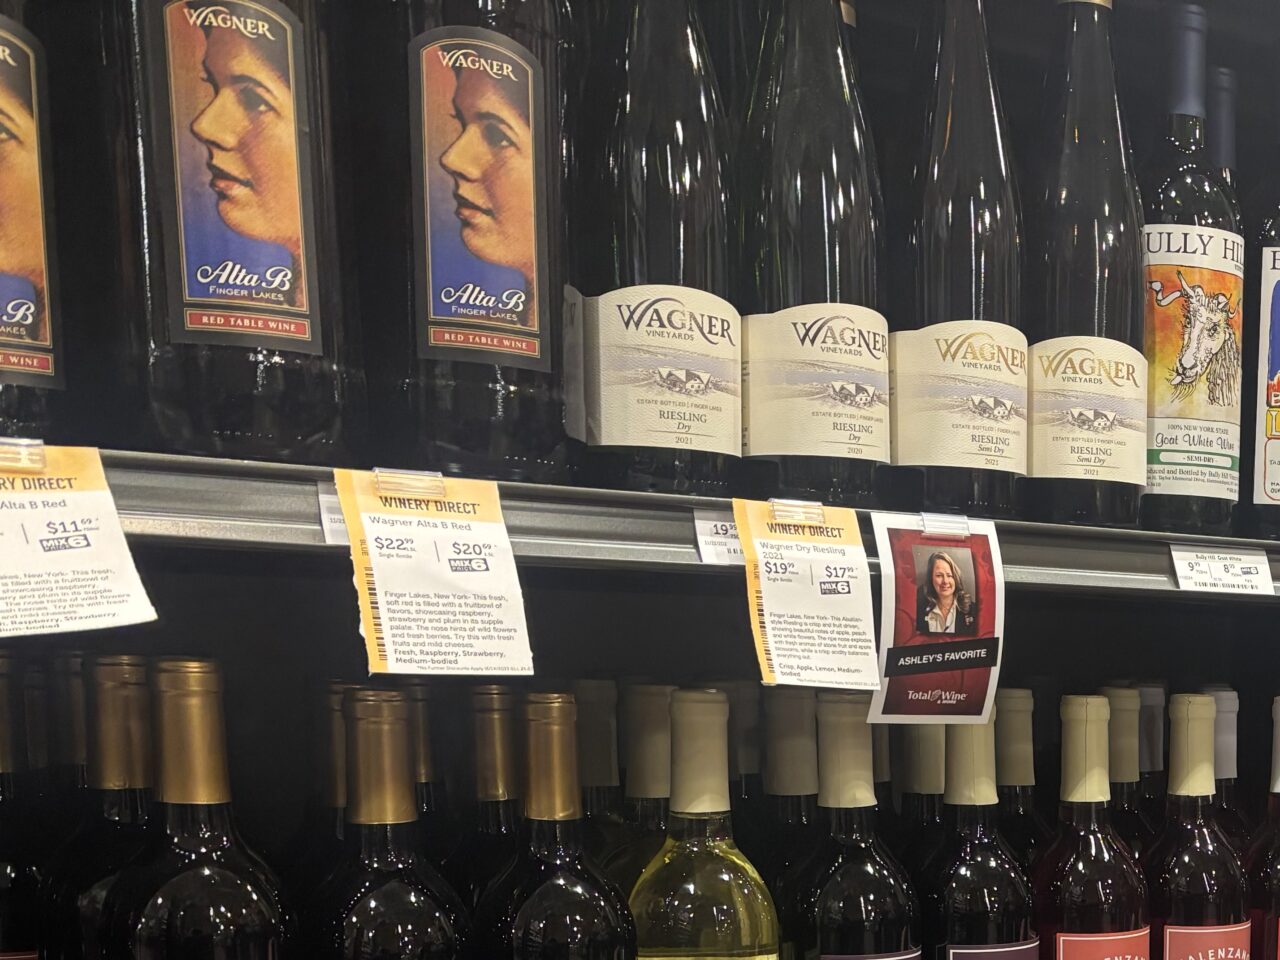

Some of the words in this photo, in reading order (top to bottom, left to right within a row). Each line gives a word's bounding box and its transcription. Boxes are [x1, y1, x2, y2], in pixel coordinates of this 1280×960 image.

[185, 6, 276, 40] WAGNER
[438, 48, 518, 81] WAGNER
[197, 260, 260, 288] Alta
[261, 266, 292, 292] B
[209, 285, 249, 299] FINGER
[251, 288, 284, 301] LAKES
[441, 283, 496, 308] Alta
[496, 289, 526, 313] B
[451, 305, 485, 318] FINGER
[487, 308, 518, 321] LAKES
[201, 315, 224, 326] RED
[227, 317, 264, 330] TABLE
[267, 319, 297, 332] WINE
[616, 297, 735, 347] WAGNER
[444, 332, 463, 344] RED
[465, 334, 498, 347] TABLE
[500, 338, 528, 350] WINE
[645, 330, 695, 342] VINEYARDS
[791, 315, 888, 359] WAGNER
[820, 345, 863, 357] VINEYARDS
[935, 332, 1027, 375] WAGNER
[10, 355, 40, 367] WINE
[961, 360, 1002, 372] VINEYARDS
[1038, 348, 1140, 388] WAGNER
[1061, 374, 1103, 385] VINEYARDS
[658, 409, 707, 424] RIESLING
[676, 421, 692, 433] Dry
[832, 422, 873, 435] RIESLING
[675, 435, 694, 445] 2021
[848, 433, 861, 444] Dry
[970, 434, 1010, 447] RIESLING
[1155, 432, 1178, 447] Goat
[1183, 433, 1214, 448] White
[847, 447, 863, 456] 2020
[976, 444, 992, 454] Semi
[992, 446, 1006, 456] Dry
[1070, 445, 1112, 457] RIESLING
[984, 458, 999, 467] 2021
[1076, 455, 1091, 465] Semi
[1092, 457, 1106, 467] Dry
[1083, 468, 1100, 477] 2021
[22, 477, 76, 491] DIRECT
[29, 501, 38, 509] B
[42, 499, 67, 509] Red
[379, 495, 430, 512] WINERY
[434, 500, 480, 515] DIRECT
[369, 516, 412, 528] Wagner
[417, 519, 438, 529] Alta
[441, 521, 449, 529] B
[451, 522, 472, 531] Red
[767, 522, 806, 537] WINERY
[808, 525, 844, 539] DIRECT
[759, 541, 794, 552] Wagner
[795, 543, 811, 554] Dry
[813, 544, 846, 556] Riesling
[763, 552, 784, 560] 2021
[384, 591, 406, 600] Finger
[408, 591, 432, 600] Lakes,
[434, 592, 449, 600] New
[473, 593, 487, 601] This
[394, 648, 418, 657] Fresh,
[419, 649, 461, 658] Raspberry,
[462, 650, 506, 658] Strawberry,
[898, 653, 943, 667] ASHLEY'S
[944, 649, 988, 664] FAVORITE
[908, 690, 931, 702] Total
[940, 690, 967, 702] Wine
